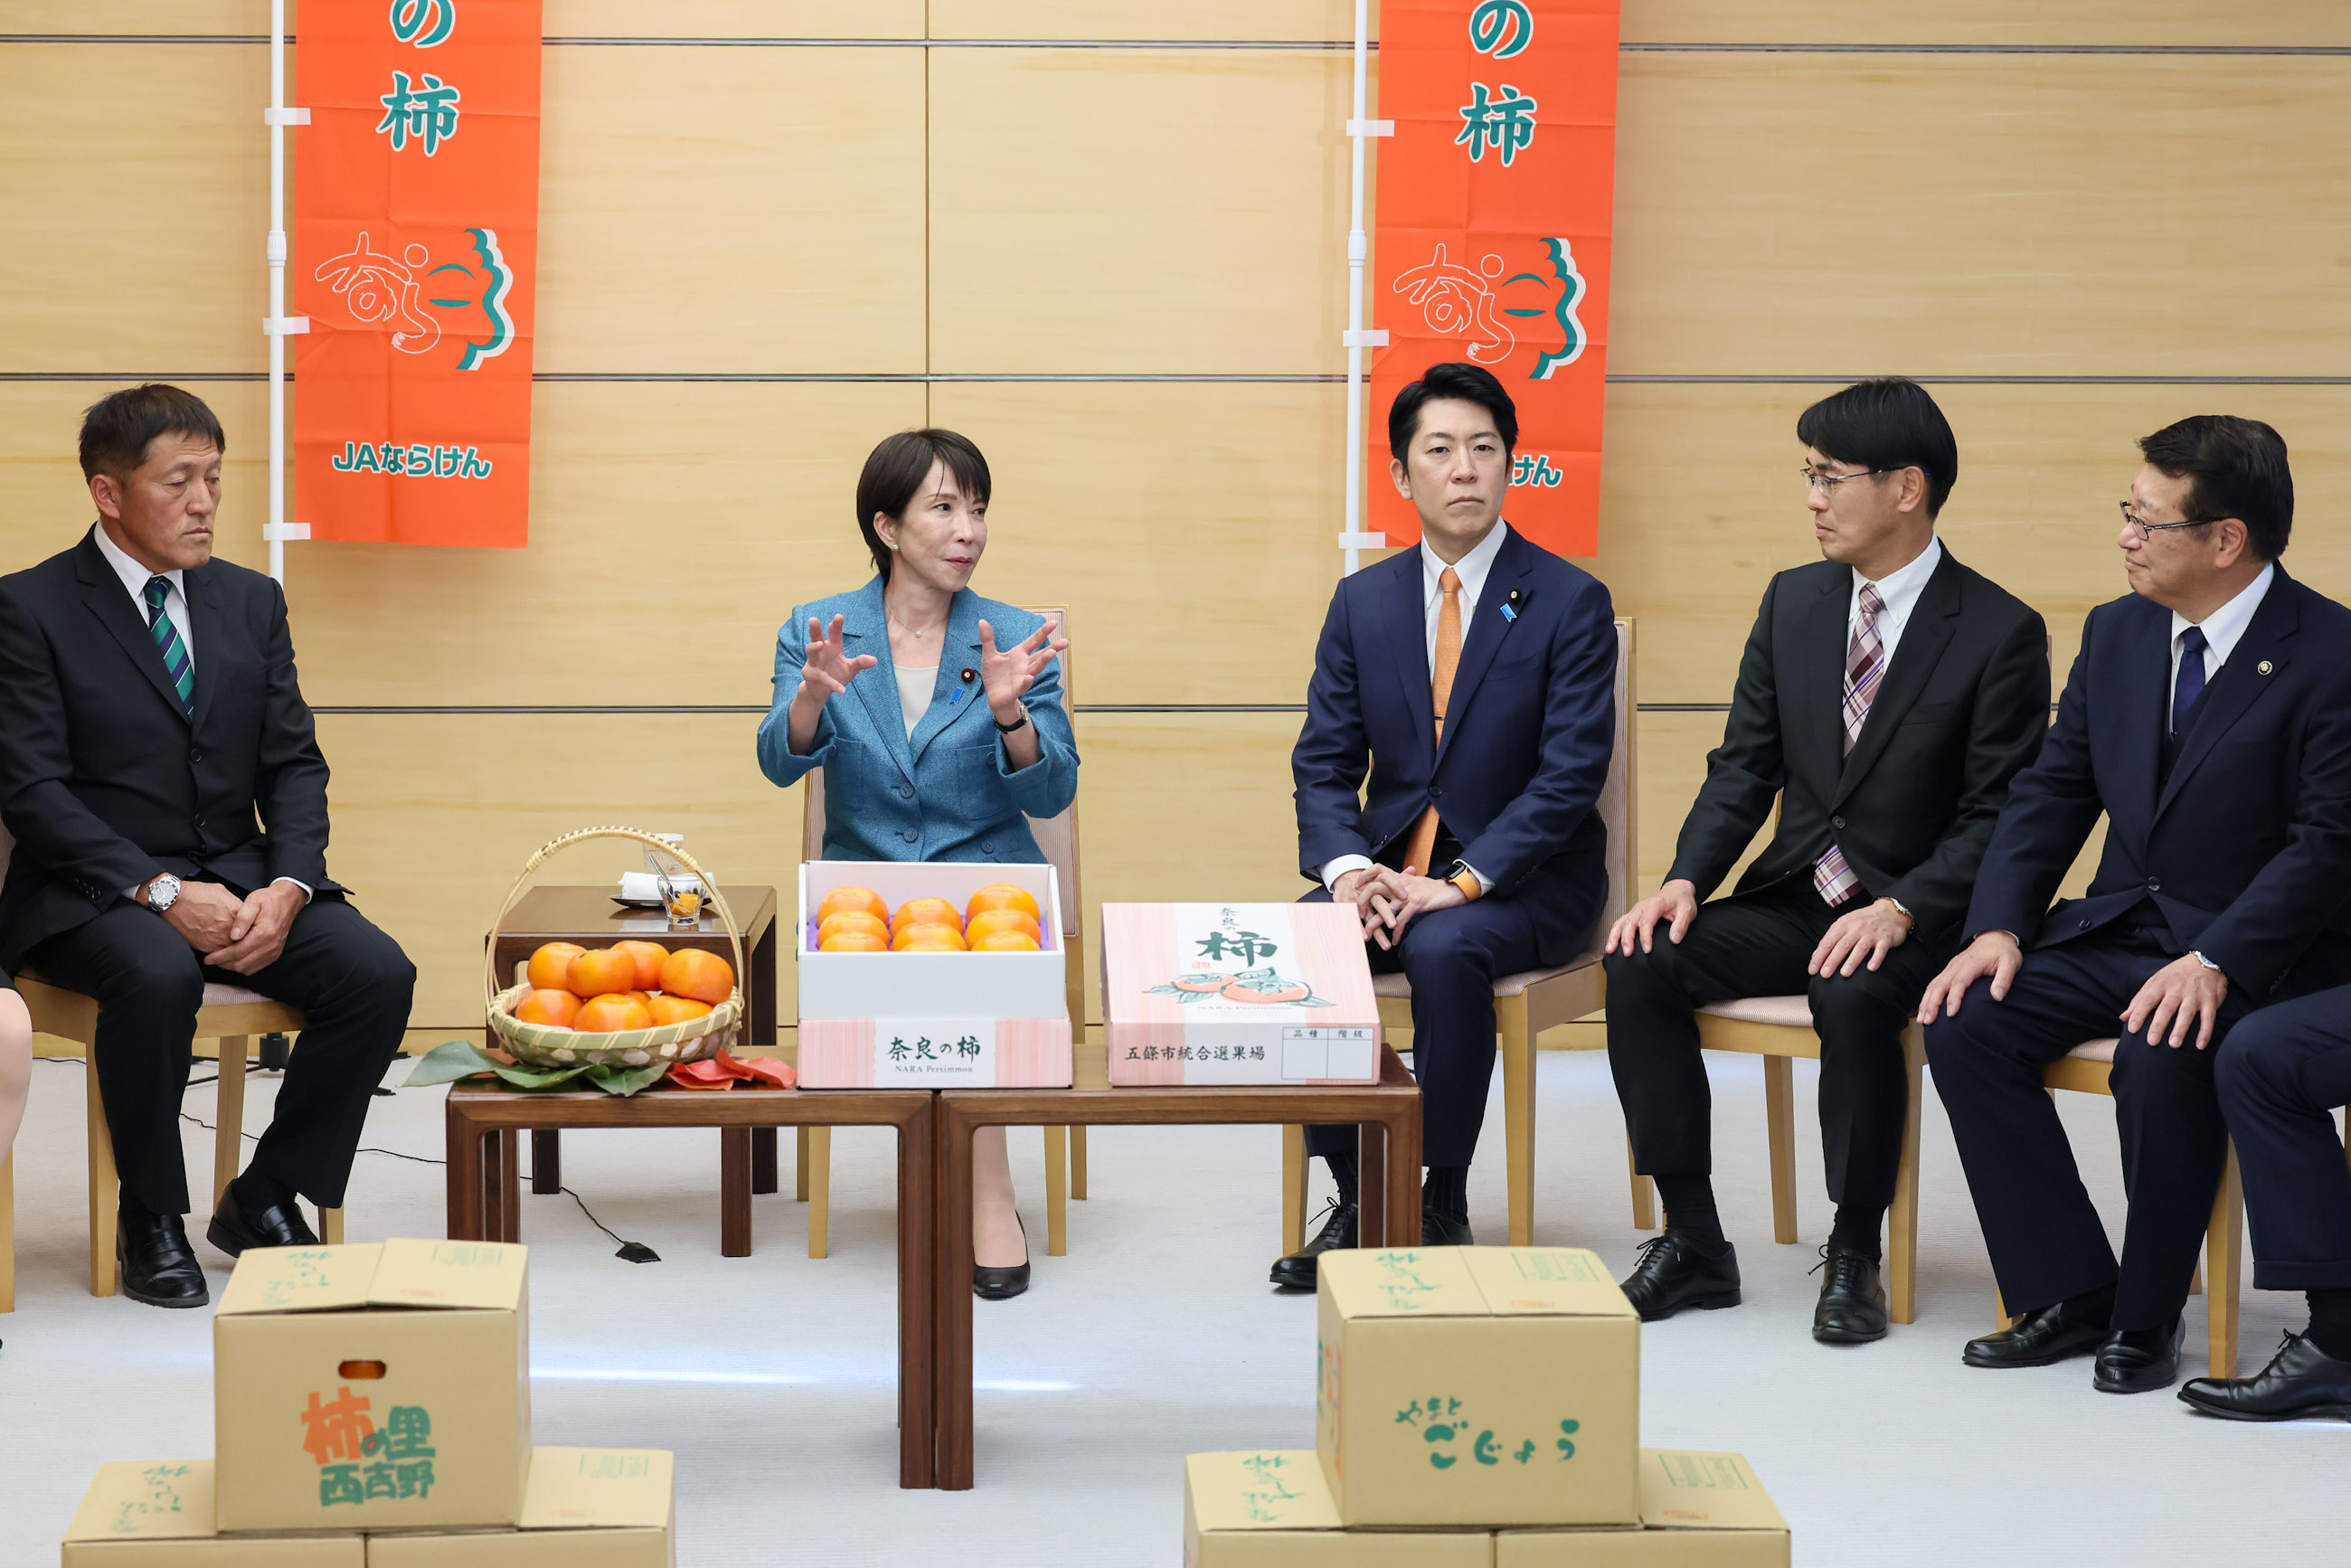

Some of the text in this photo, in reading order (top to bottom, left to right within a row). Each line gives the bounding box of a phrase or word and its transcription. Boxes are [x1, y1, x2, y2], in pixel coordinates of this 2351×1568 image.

[1454, 0, 1537, 167] の柿
[332, 441, 493, 479] JAならけん
[888, 1035, 981, 1063] 奈良の柿
[1125, 1045, 1266, 1062] 五條市統合選果場
[300, 1385, 436, 1466] 柿の里
[1395, 1396, 1462, 1427] やまと
[1423, 1420, 1580, 1469] ごじょう
[319, 1460, 435, 1507] 西吉野
